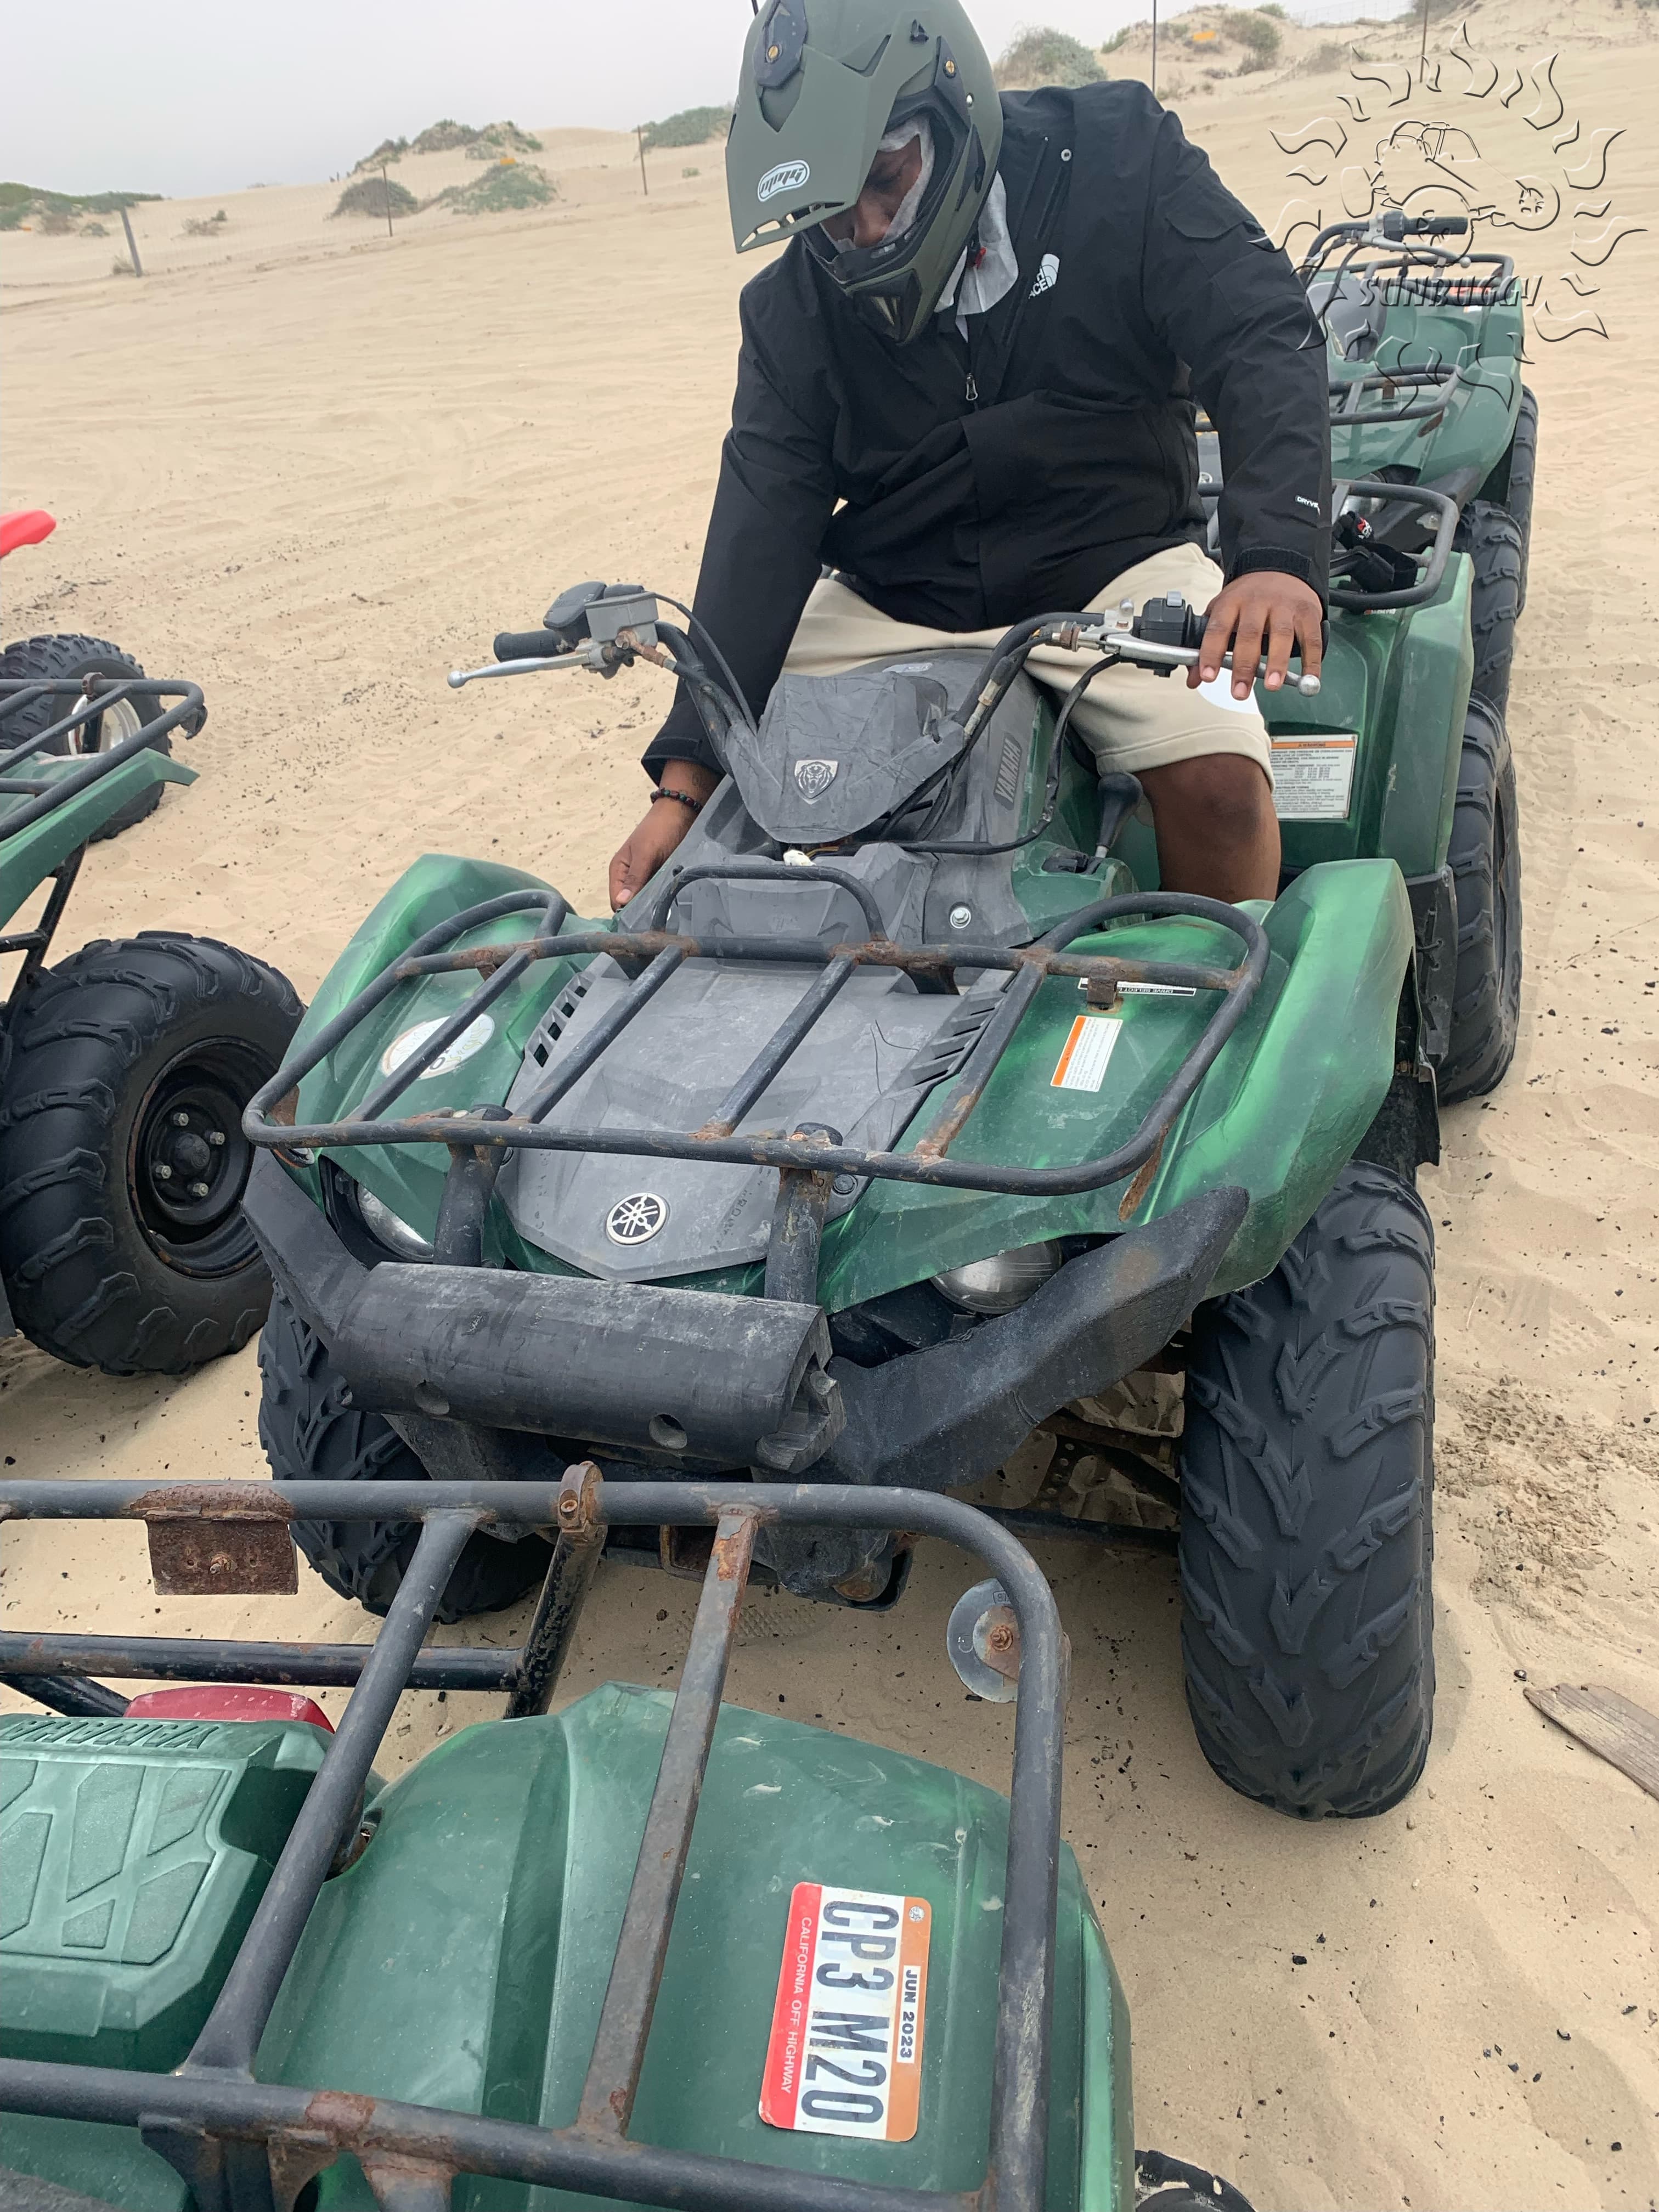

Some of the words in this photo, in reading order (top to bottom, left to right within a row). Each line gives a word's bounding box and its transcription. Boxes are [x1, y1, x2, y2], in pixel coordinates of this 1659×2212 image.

[995, 738, 1020, 803] YAMAHA
[1, 1720, 219, 1750] YAMAHA
[793, 1917, 812, 1994] CALIFORNIA
[816, 1900, 900, 1991] CP3
[790, 2000, 802, 2028] OFF
[904, 1970, 917, 2004] JUN
[781, 2030, 798, 2094] HIGHWAY
[801, 2010, 890, 2124] M20
[900, 2011, 915, 2059] 2023
